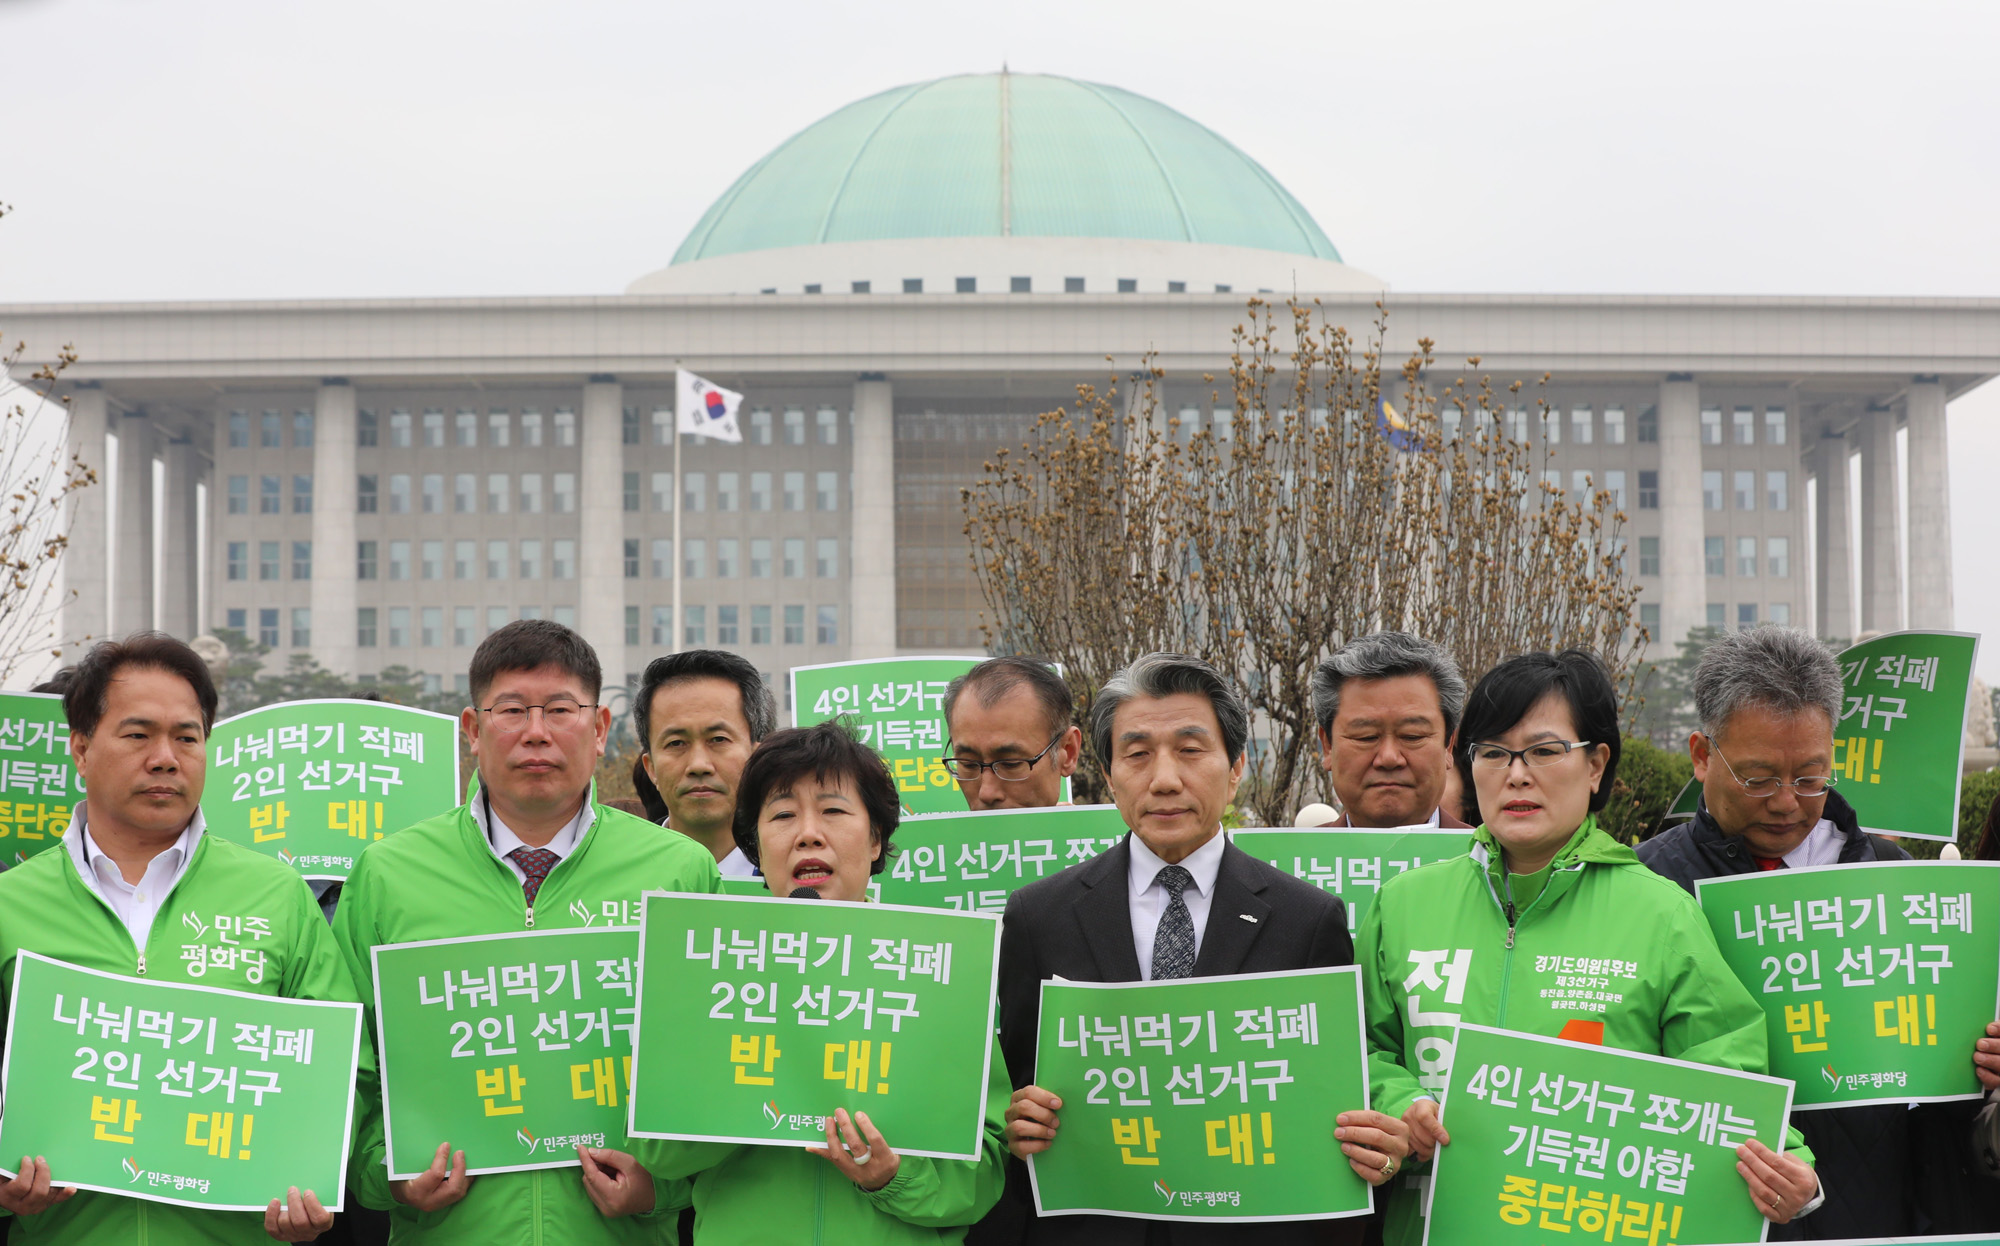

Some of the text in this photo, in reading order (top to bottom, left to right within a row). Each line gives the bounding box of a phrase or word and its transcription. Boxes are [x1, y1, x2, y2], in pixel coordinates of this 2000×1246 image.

[1875, 655, 1939, 692] 적폐
[813, 681, 861, 715] 4인
[1841, 694, 1907, 731] 거구
[215, 722, 424, 767] 나눠먹기 적폐
[858, 719, 942, 751] 기득권
[232, 760, 403, 801] 2인 선거구
[1831, 737, 1883, 784] 대!
[250, 800, 384, 843] 반 대!
[299, 854, 353, 869] 민주평화당
[891, 845, 947, 883] 4인
[955, 840, 1057, 880] 선거구
[214, 914, 272, 945] 민주
[1734, 892, 1973, 946] 나눠먹기 적폐
[180, 944, 267, 984] 평화당
[685, 927, 952, 985] 나눠먹기 적폐
[1761, 943, 1953, 993] 2인 선거구
[418, 957, 639, 1011] 나눠먹기 적
[1555, 975, 1609, 989] 제3선거구
[53, 994, 314, 1064] 나눠먹기 적폐
[708, 981, 919, 1032] 2인 선거구
[1058, 1002, 1319, 1057] 나눠먹기 적폐
[1784, 994, 1937, 1053] 반 대!
[450, 1014, 517, 1058] 2인
[71, 1047, 281, 1106] 2인 선거구
[730, 1035, 892, 1095] 반 대!
[1084, 1059, 1294, 1106] 2인 선거구
[1845, 1071, 1908, 1091] 민주평화당
[476, 1065, 526, 1117] 반
[1466, 1063, 1757, 1149] 4인 선거구 쪼개는
[90, 1095, 254, 1160] 반 대!
[543, 1132, 605, 1152] 민주평화당
[788, 1114, 843, 1132] 민주평
[1111, 1112, 1276, 1165] 반 대!
[147, 1171, 211, 1194] 민주평화당
[1503, 1125, 1694, 1196] 기득권 야합
[1180, 1191, 1241, 1207] 민주평화당
[1498, 1174, 1683, 1246] 중단하라!
